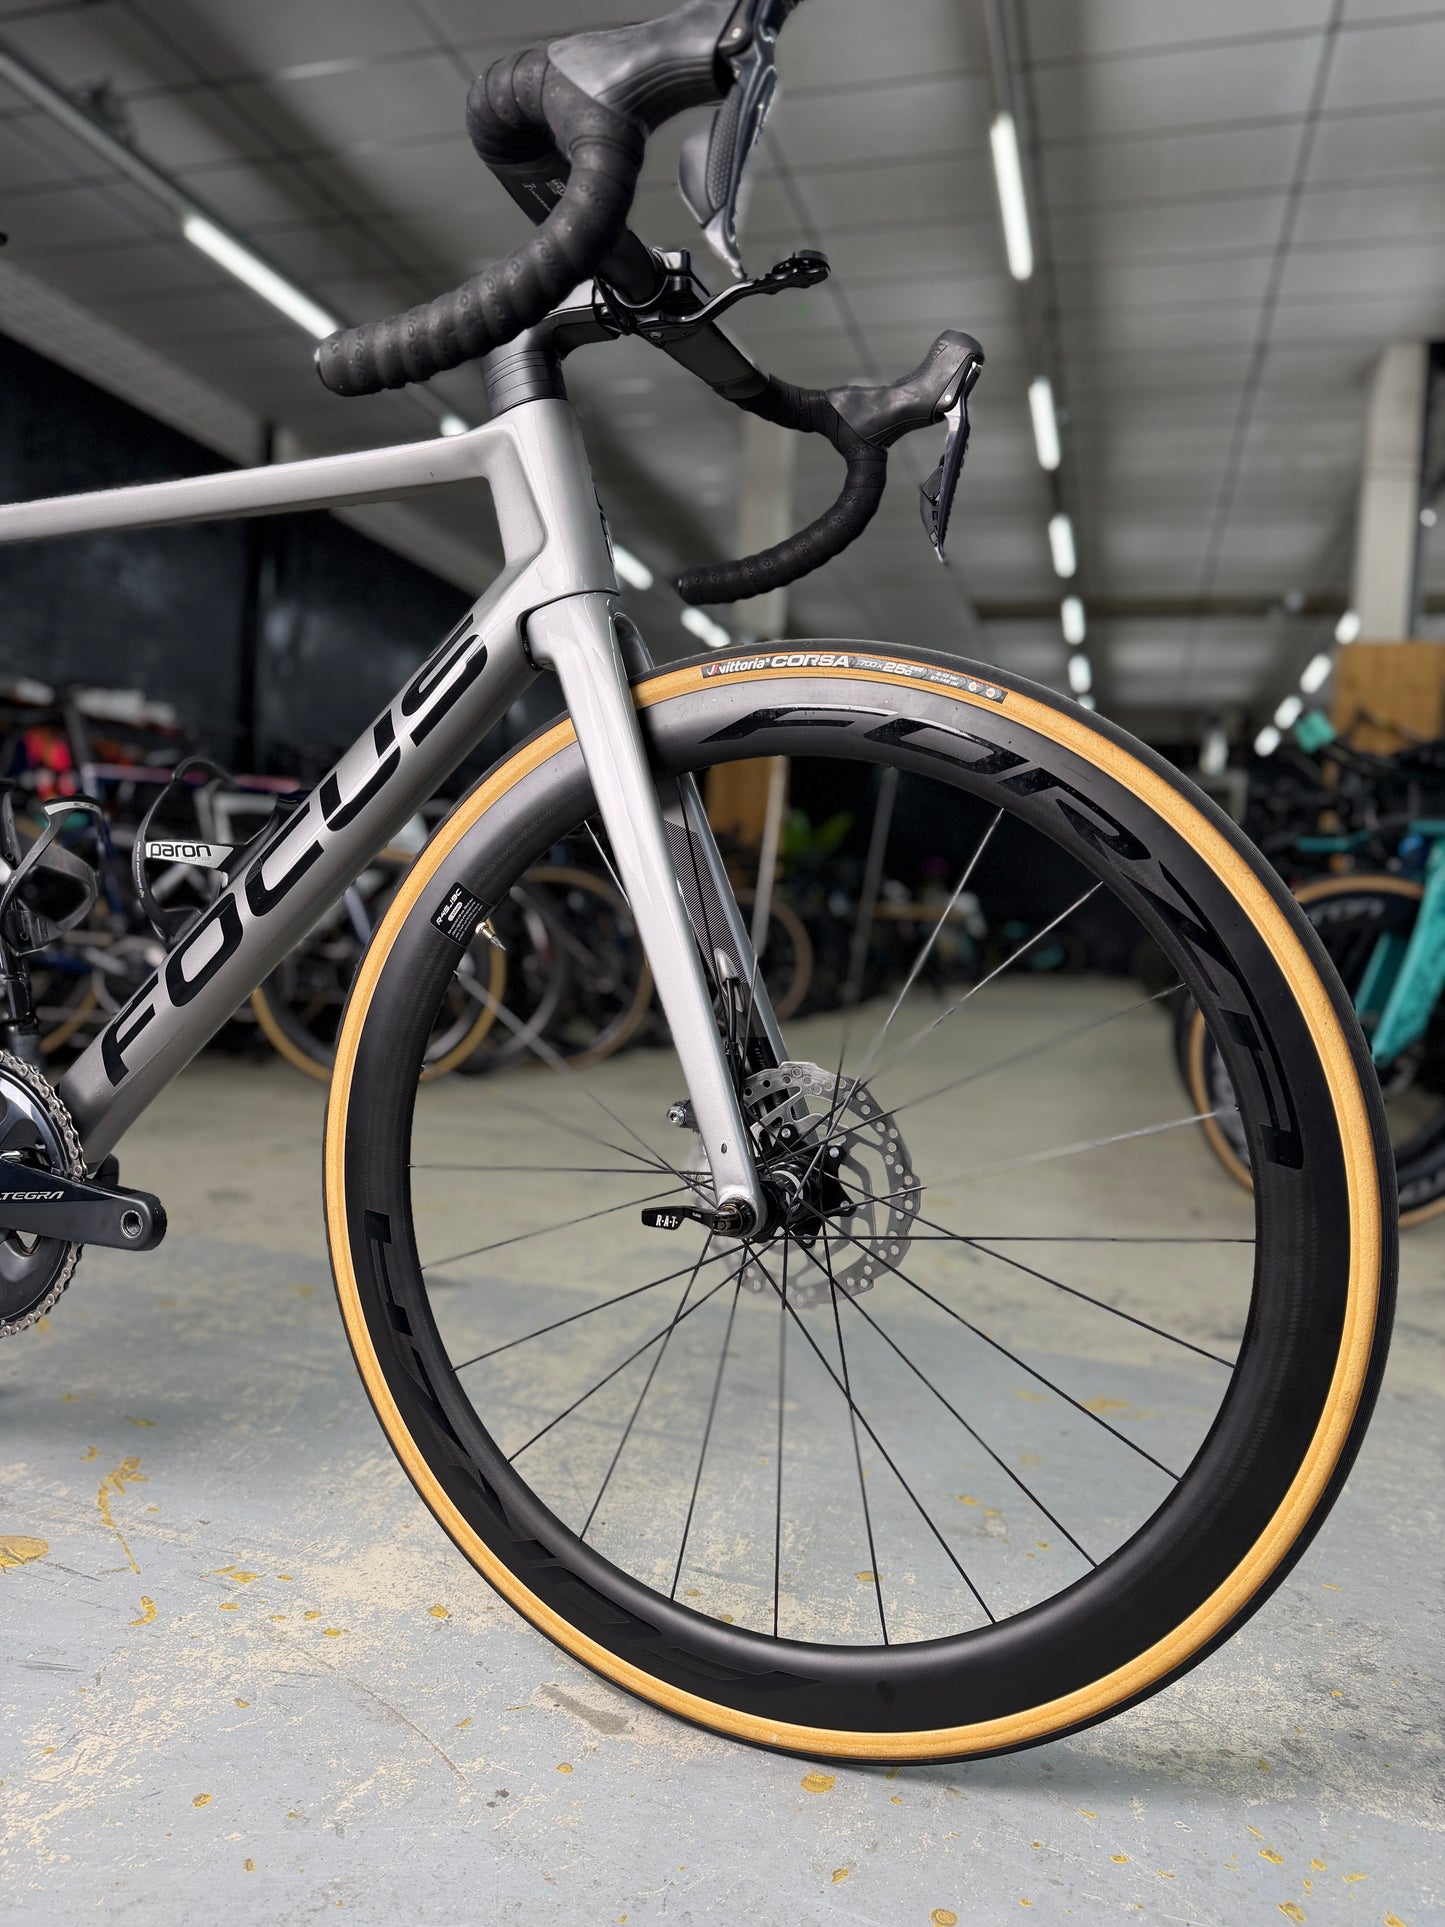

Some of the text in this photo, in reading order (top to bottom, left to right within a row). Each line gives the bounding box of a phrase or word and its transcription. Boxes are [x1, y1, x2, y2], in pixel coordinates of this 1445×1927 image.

[718, 657, 766, 676] vittoria
[771, 654, 849, 668] CORSA
[101, 614, 487, 1088] FOCUS
[151, 843, 211, 858] paron
[699, 704, 1304, 1170] FORZA
